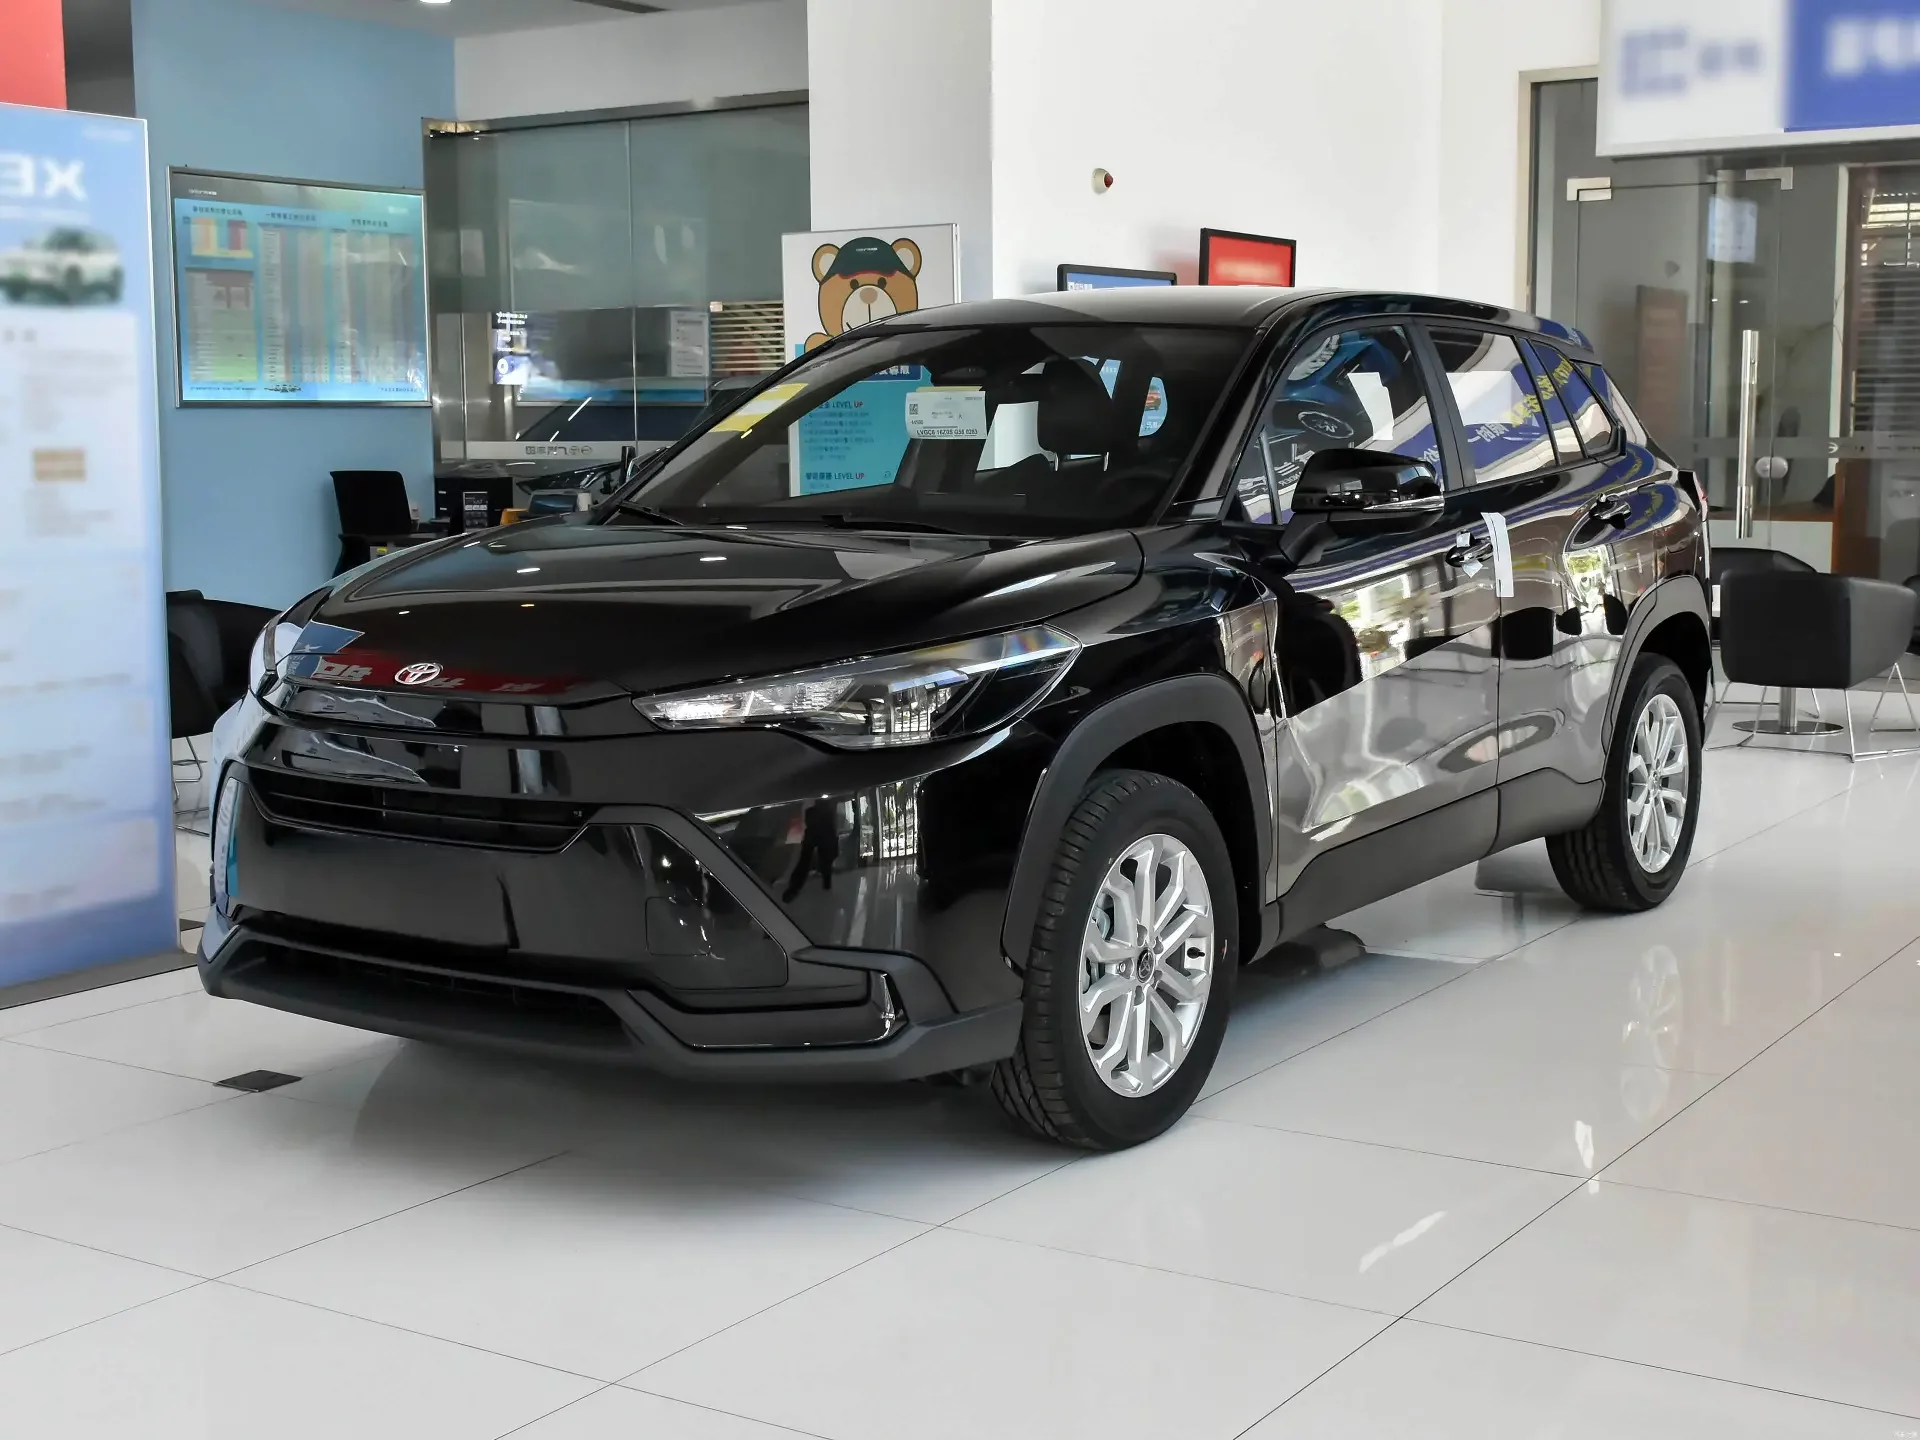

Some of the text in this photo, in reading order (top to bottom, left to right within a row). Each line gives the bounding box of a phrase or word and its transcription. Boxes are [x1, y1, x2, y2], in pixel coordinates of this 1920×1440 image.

[832, 401, 853, 409] LEVEL
[834, 472, 854, 480] LEVEL
[855, 472, 865, 480] UP
